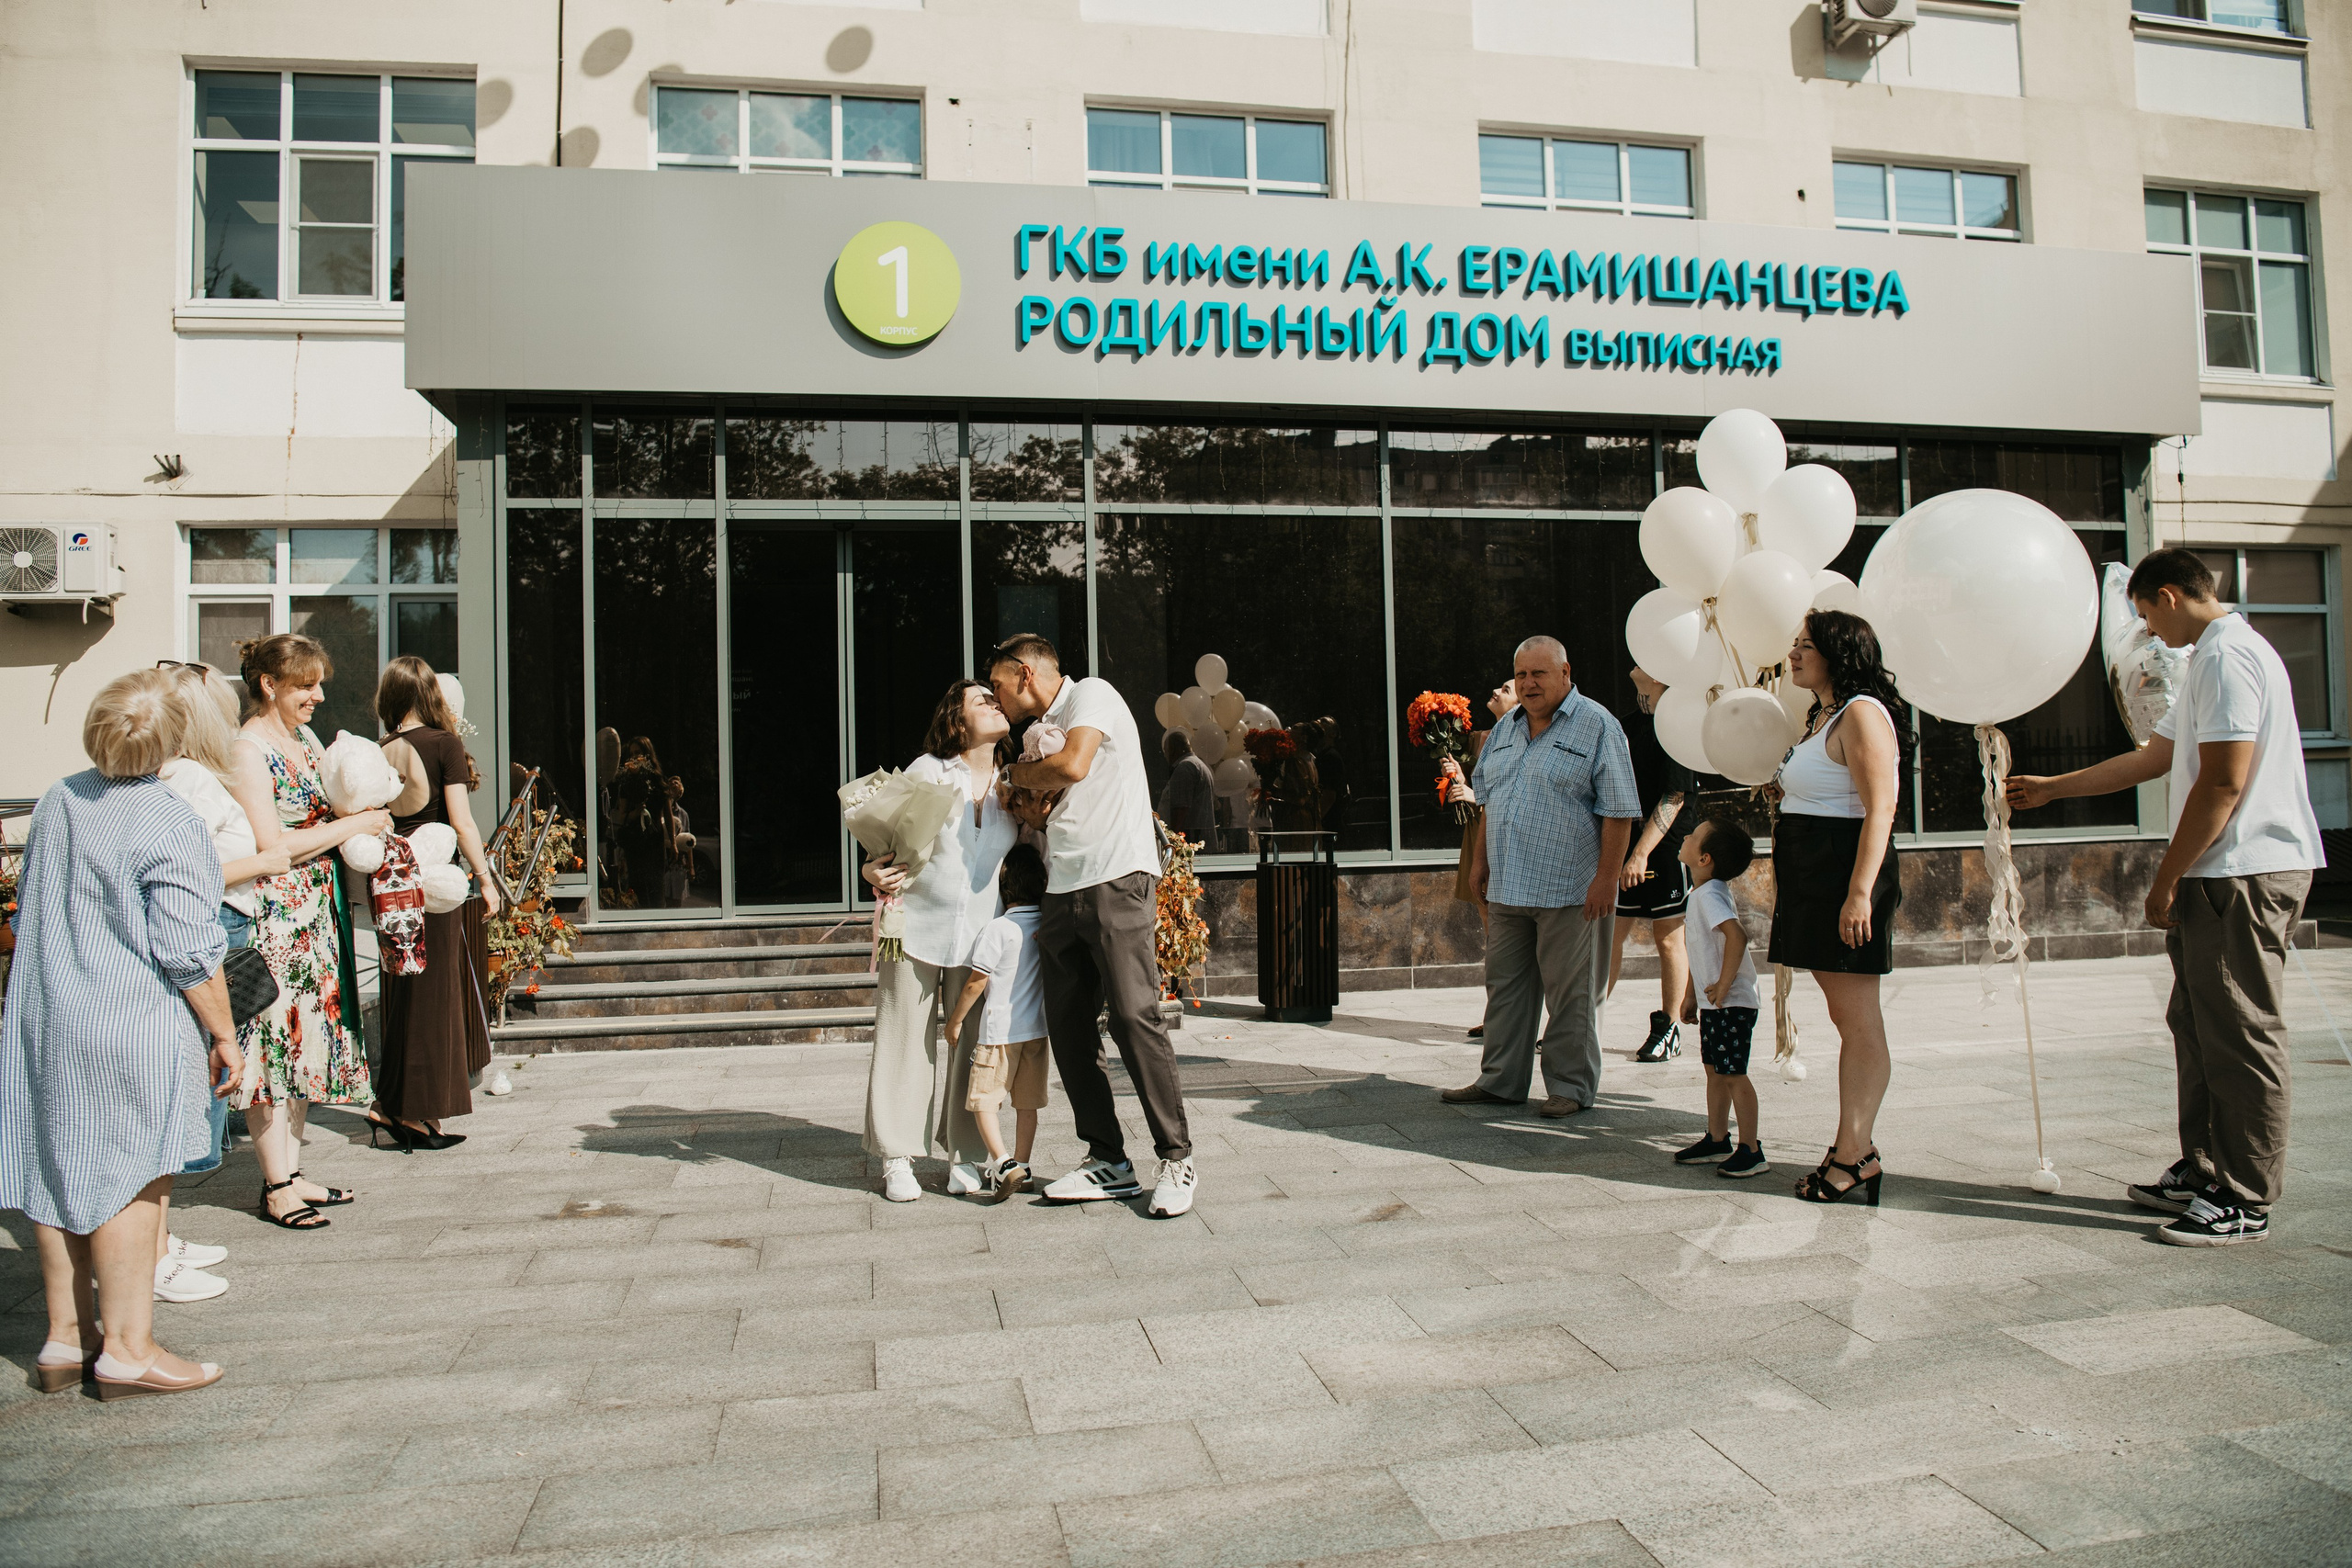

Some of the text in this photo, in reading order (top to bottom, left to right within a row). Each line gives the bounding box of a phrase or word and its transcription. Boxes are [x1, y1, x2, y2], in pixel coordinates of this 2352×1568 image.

[877, 245, 909, 319] 1
[1020, 223, 1910, 314] ГКБ имени А.К. ЕРАМИШАНЦЕВА
[879, 325, 919, 336] КОРПУС
[1021, 295, 1781, 369] РОДИЛЬНЫЙ ДОМ ВЫПИСНАЯ
